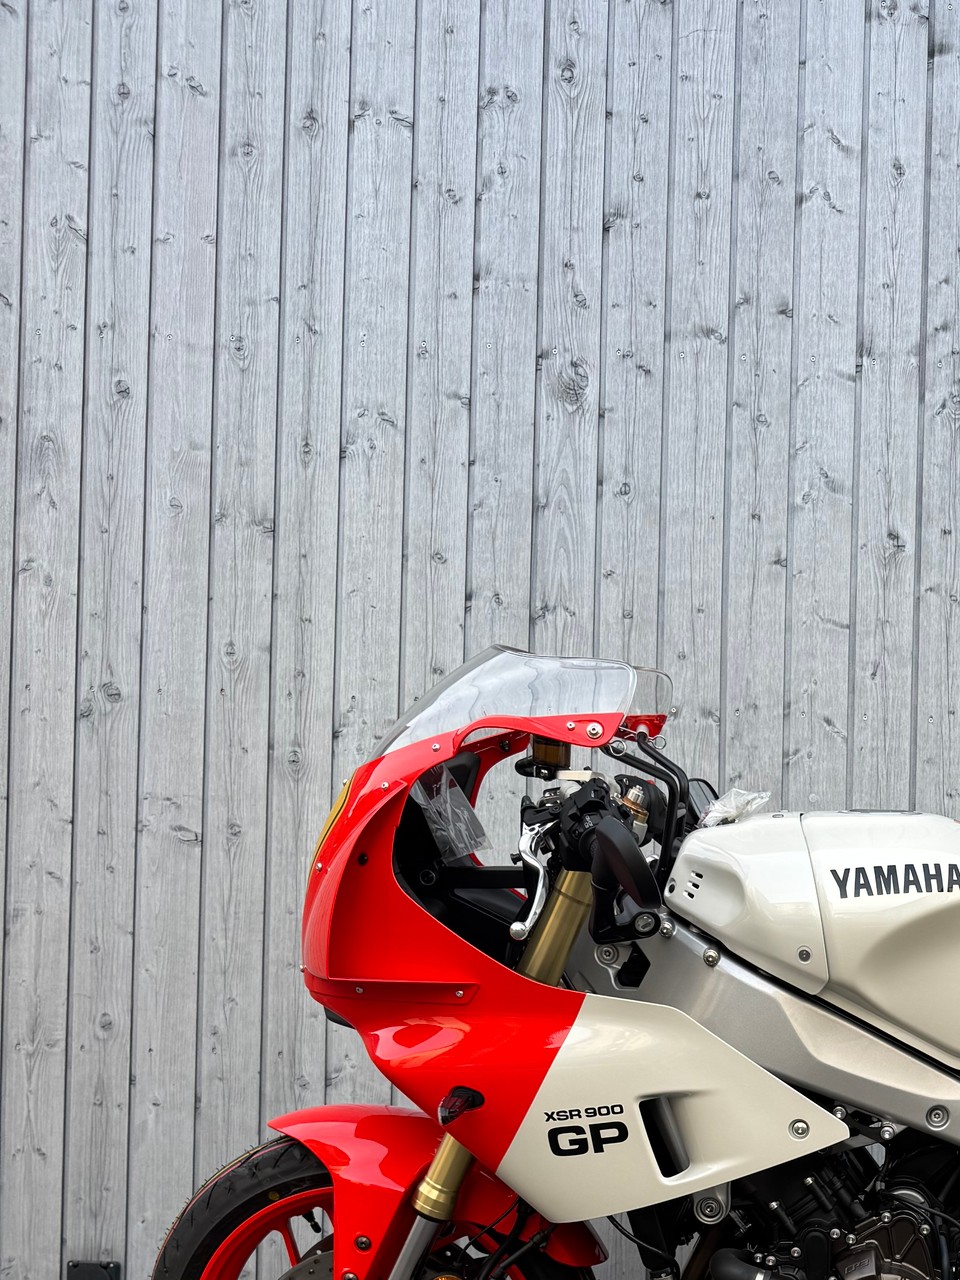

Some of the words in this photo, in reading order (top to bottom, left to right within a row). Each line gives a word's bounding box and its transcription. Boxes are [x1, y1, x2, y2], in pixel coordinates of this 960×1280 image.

[544, 1108, 582, 1122] XSR
[584, 1104, 624, 1118] 900
[547, 1121, 629, 1157] GP
